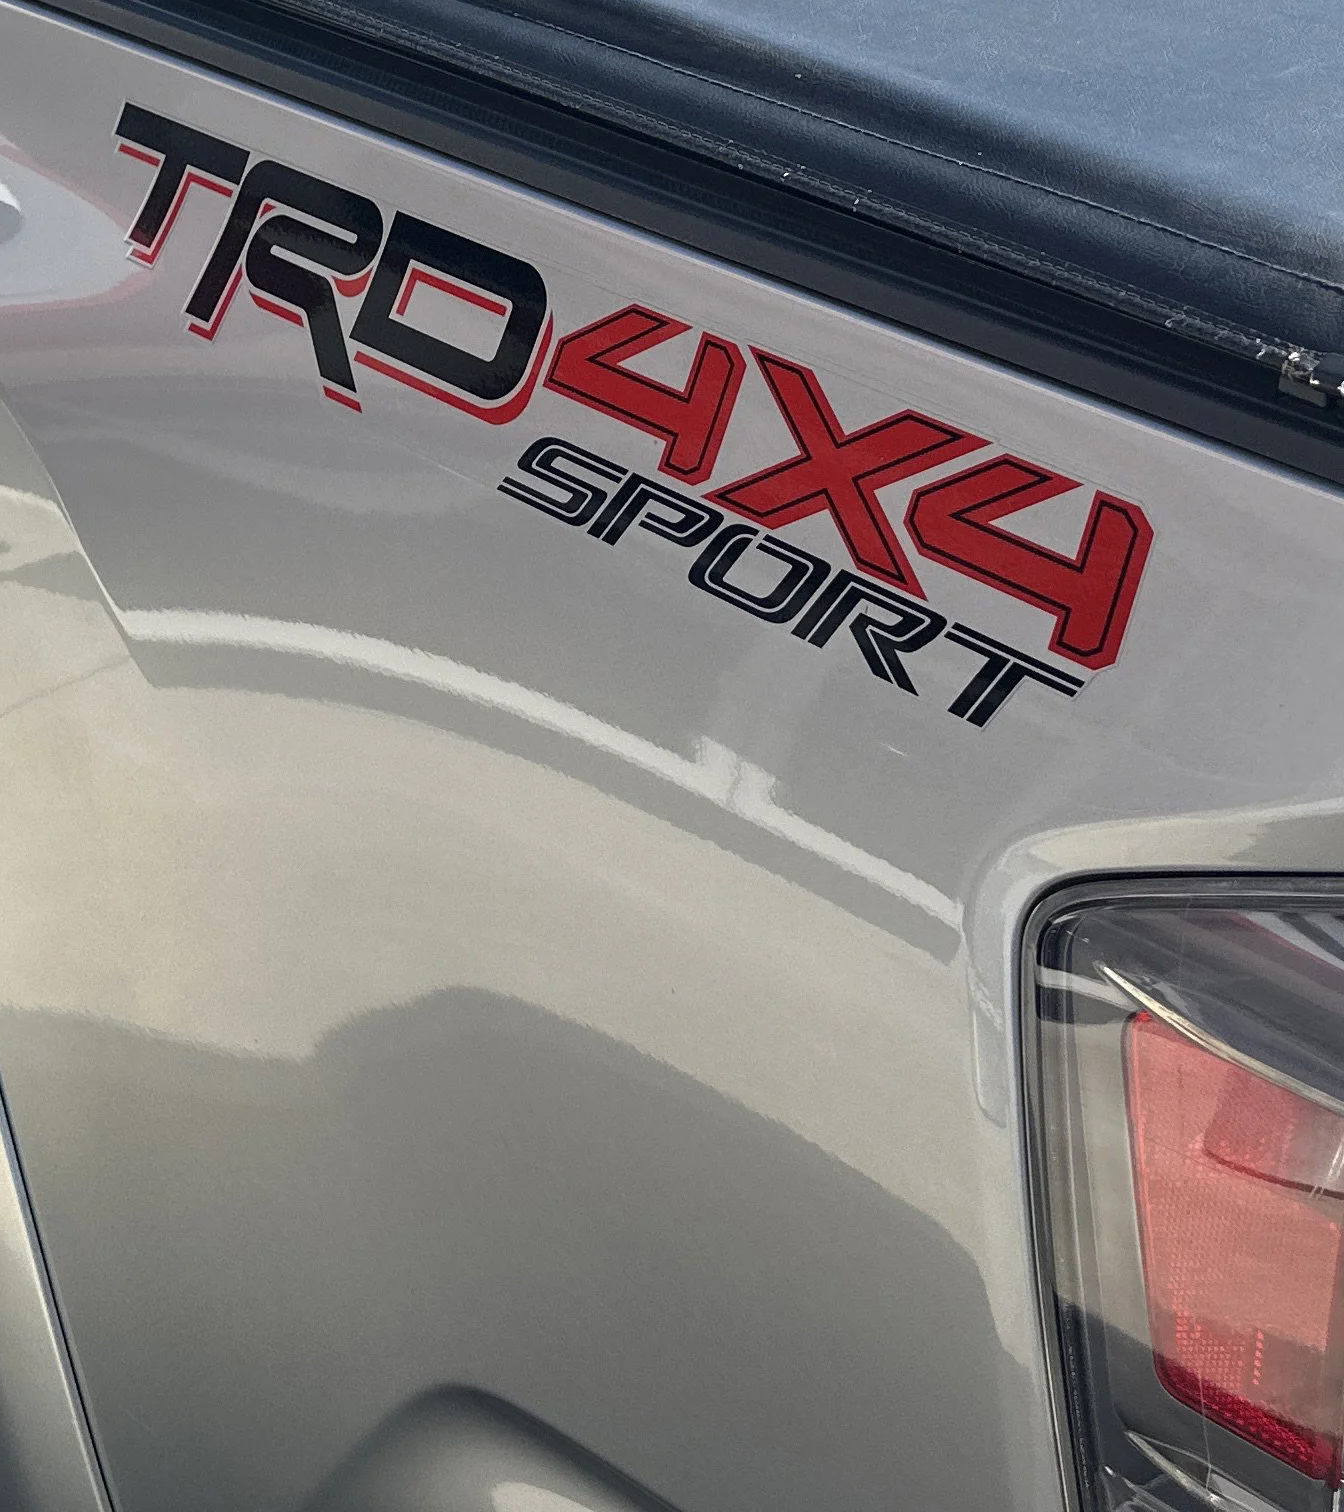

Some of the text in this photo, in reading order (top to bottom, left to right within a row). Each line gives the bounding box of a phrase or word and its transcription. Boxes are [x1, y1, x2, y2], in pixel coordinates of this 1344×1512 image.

[114, 99, 1155, 675] TRD 4X4
[496, 435, 1093, 730] SPORT
